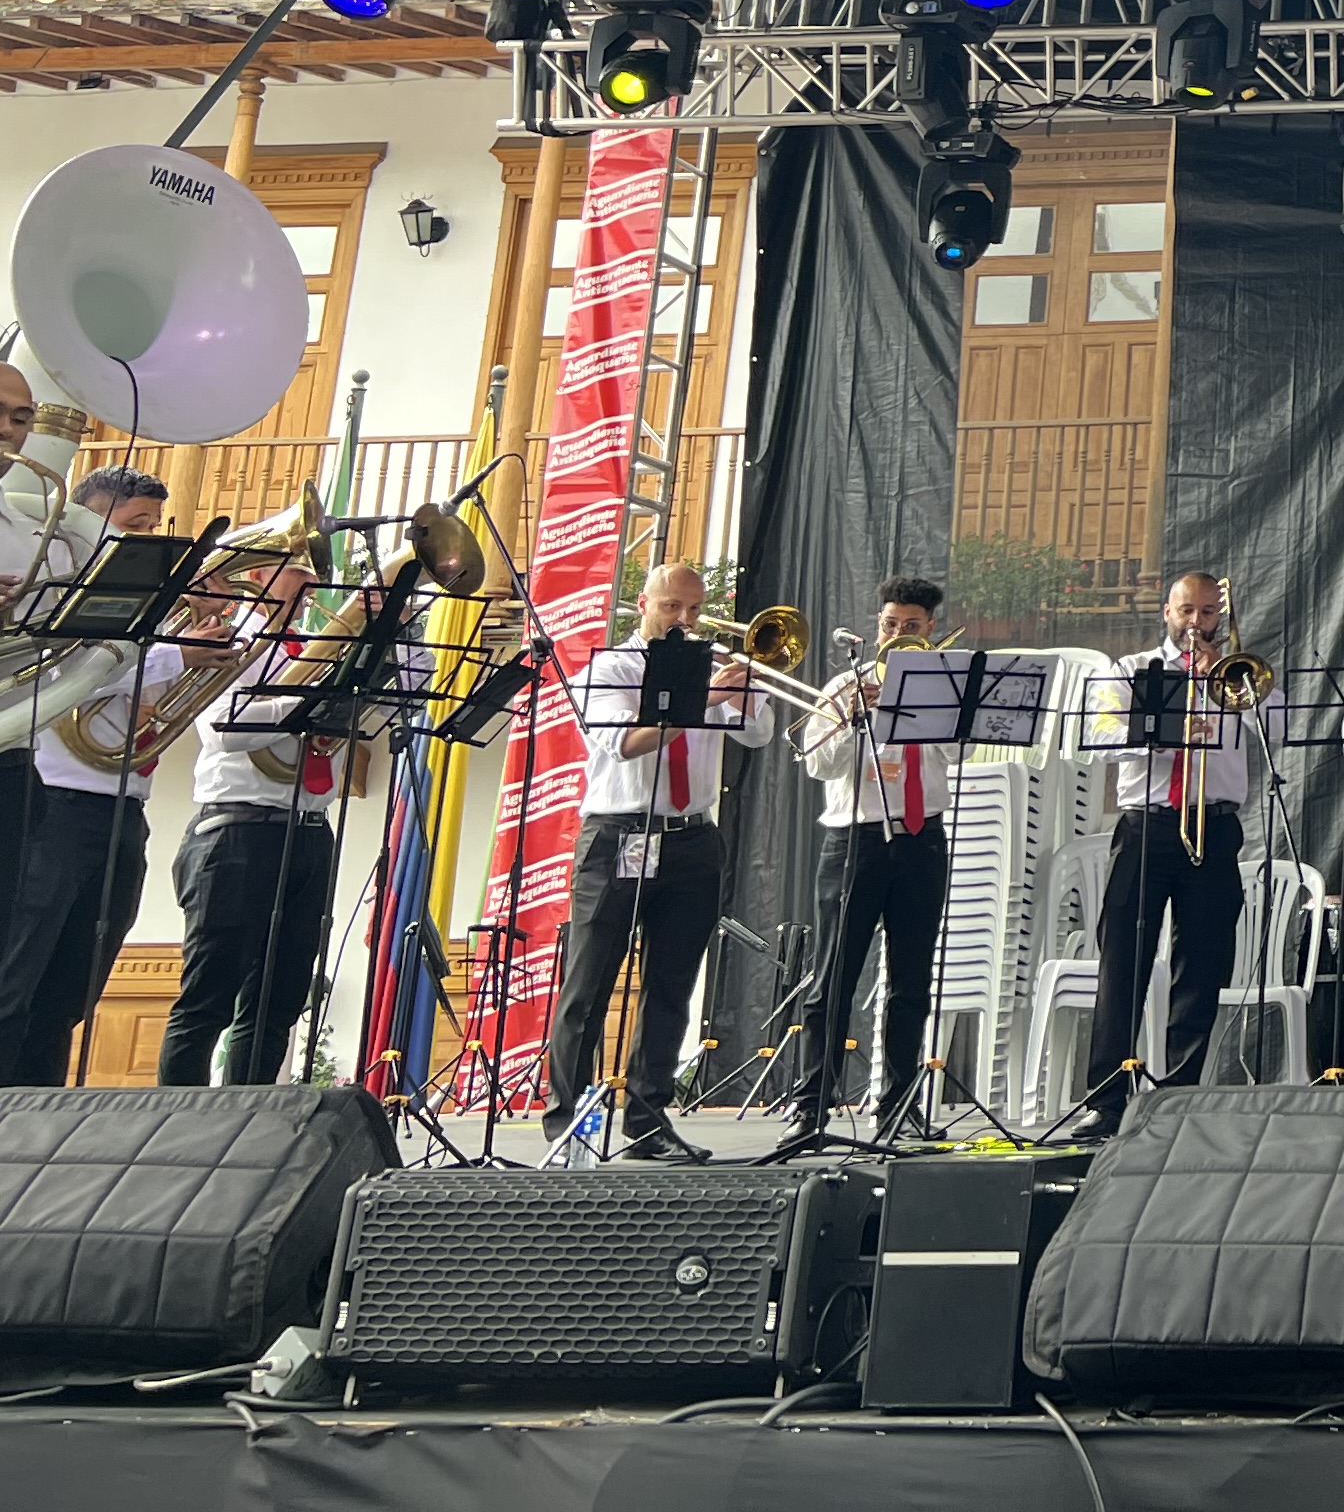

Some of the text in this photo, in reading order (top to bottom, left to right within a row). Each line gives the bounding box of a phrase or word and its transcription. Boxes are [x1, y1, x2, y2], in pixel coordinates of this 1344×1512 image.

[149, 165, 215, 205] YAMAHA
[590, 178, 660, 209] Aguardiente
[573, 270, 648, 301] Antioqueño
[576, 260, 649, 288] Aguardiente
[562, 352, 637, 384] Antioqueño
[565, 341, 638, 371] Aguardiente
[549, 435, 627, 468] Antioqueño
[552, 426, 627, 456] Aguardiente
[538, 519, 615, 553] Antioqueño
[541, 510, 617, 541] Aguardiente
